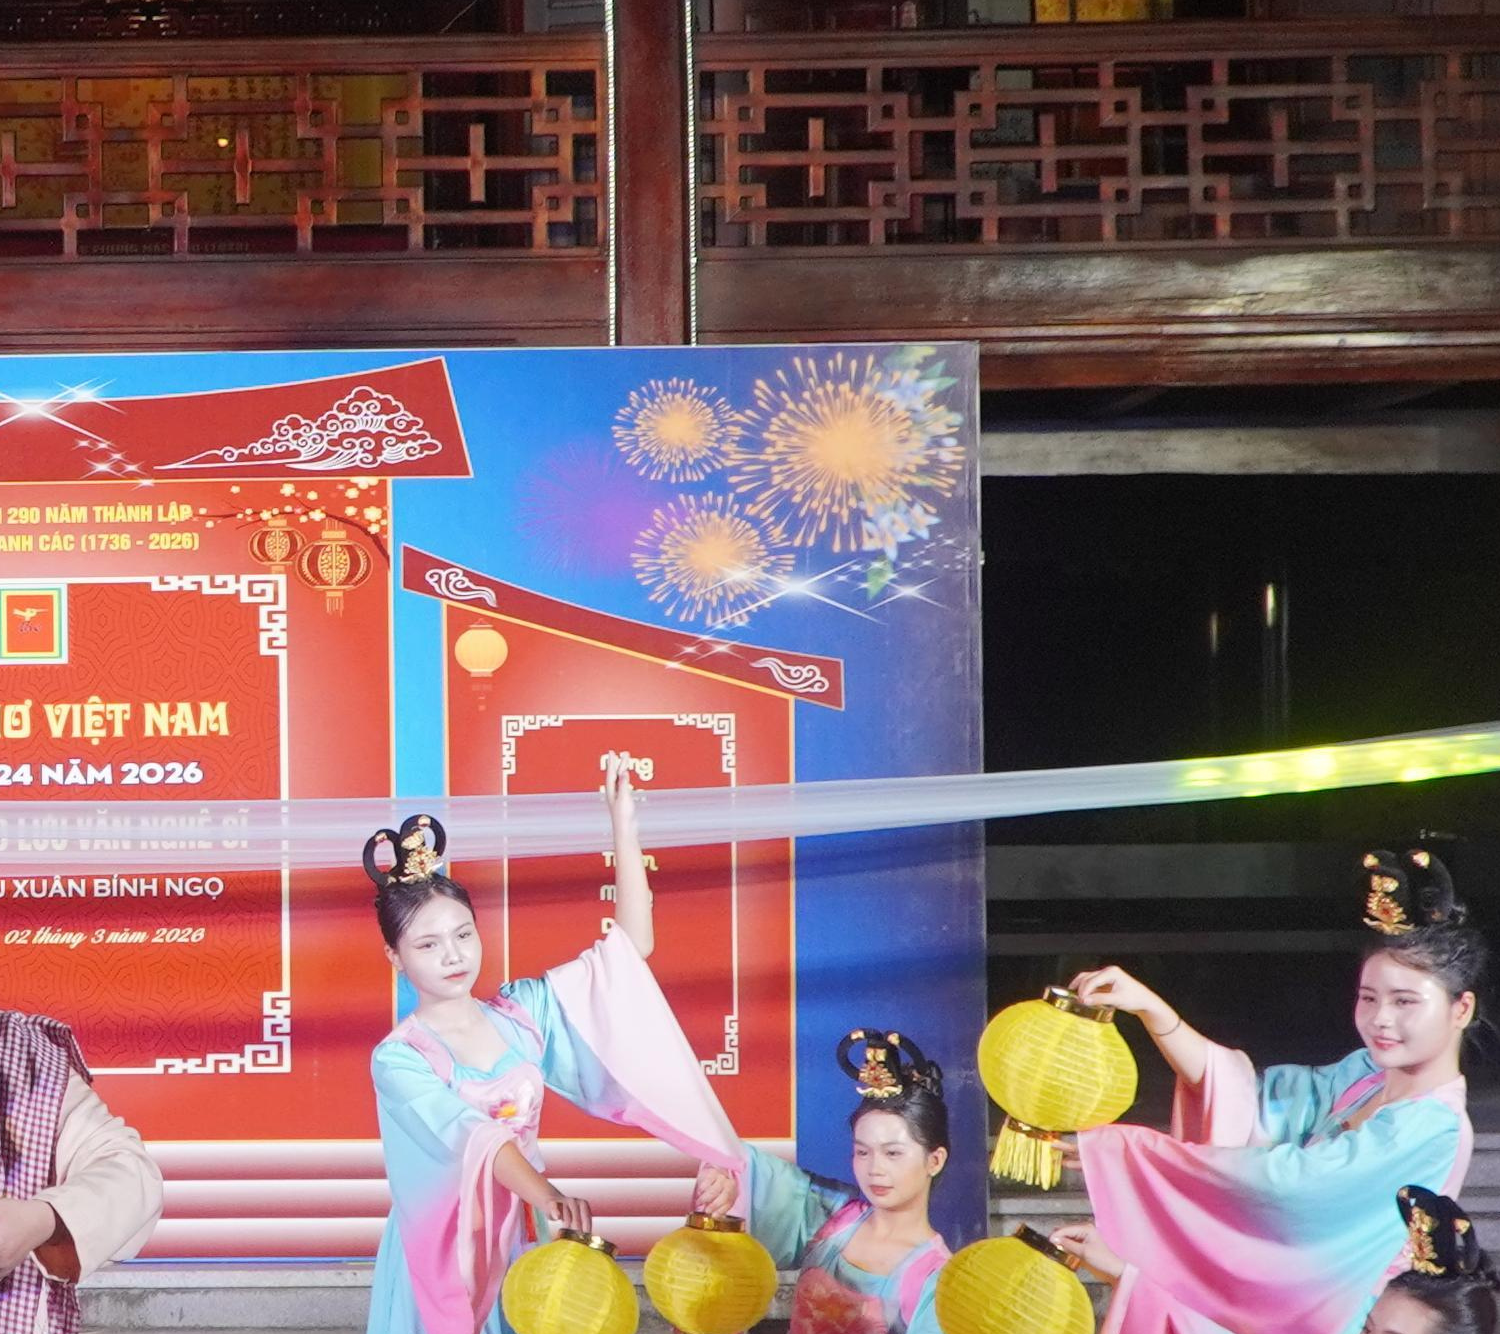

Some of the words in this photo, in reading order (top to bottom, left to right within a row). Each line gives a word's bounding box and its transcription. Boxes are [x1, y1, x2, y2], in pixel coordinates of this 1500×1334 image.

[7, 506, 41, 525] 290
[45, 503, 88, 524] NĂM
[92, 502, 153, 524] THÀNH
[157, 501, 194, 526] LẬP
[38, 531, 76, 551] CÁC
[80, 533, 132, 552] (1736
[148, 532, 200, 551] 2026)
[44, 695, 132, 746] VIỆT
[143, 700, 230, 738] NAM
[40, 758, 114, 787] NĂM
[121, 761, 204, 786] 2026
[12, 874, 87, 898] XUÂN
[93, 872, 158, 898] BÍNH
[165, 876, 224, 900] NGỌ
[4, 929, 29, 944] 02
[32, 926, 87, 948] tháng
[91, 928, 102, 944] 3
[106, 928, 148, 944] năm
[151, 927, 206, 944] 2026
